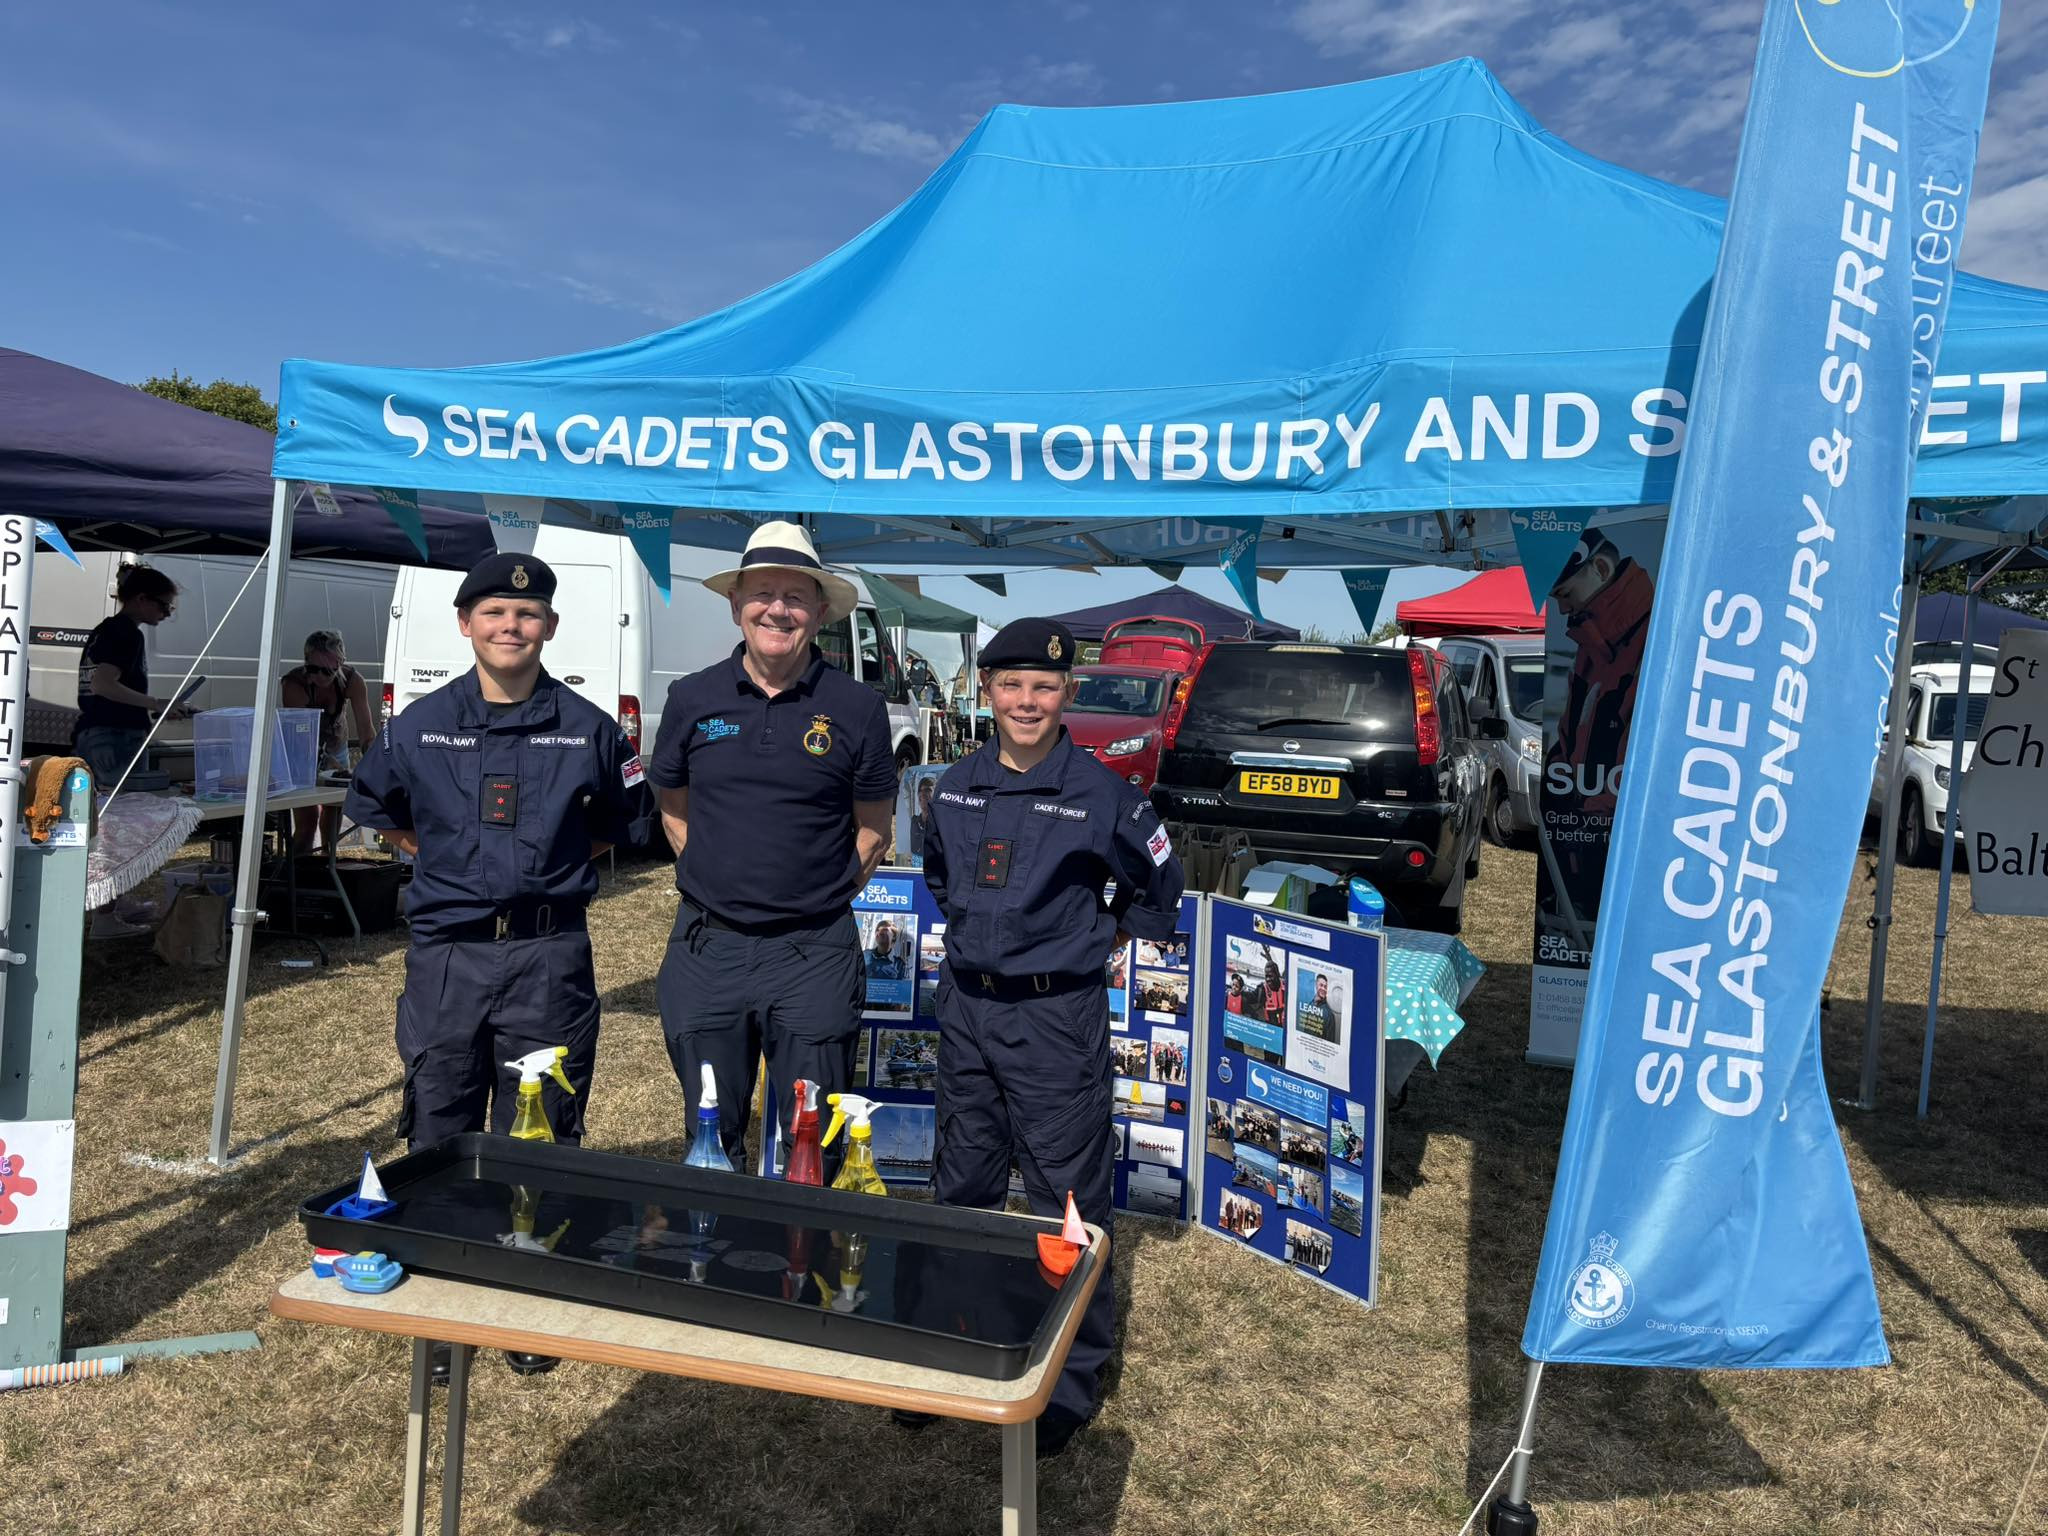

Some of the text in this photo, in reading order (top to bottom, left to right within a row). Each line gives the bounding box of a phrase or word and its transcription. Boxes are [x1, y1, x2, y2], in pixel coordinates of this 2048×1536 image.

[442, 370, 2047, 482] SEA CADETS GLASTONBURY AND SET
[502, 511, 519, 519] SEA
[635, 511, 653, 519] SEA
[1532, 510, 1557, 520] SEA
[502, 519, 537, 529] CADETS
[636, 518, 670, 529] CADETS
[1531, 521, 1582, 532] CADETS
[0, 519, 23, 676] SPLAT
[1696, 102, 1899, 1118] GLASTONBURY & STREET
[411, 669, 449, 677] TRANSIT
[1994, 656, 2040, 698] St
[708, 725, 740, 733] CADETS
[421, 734, 477, 747] ROYAL NAVY
[530, 736, 586, 746] CADET FORCES
[1247, 774, 1332, 795] EF58 BYD
[939, 792, 986, 808] ROYAL NAVY
[1182, 797, 1221, 807] X-TRAIL
[1034, 803, 1087, 819] CADET FORCES
[1545, 810, 1613, 828] Grab your
[1545, 830, 1553, 840] a
[1556, 828, 1599, 843] better
[1636, 590, 1763, 1106] SEA CADETS
[867, 885, 888, 895] SEA
[866, 894, 909, 905] CADETS
[1540, 935, 1569, 949] SEA
[1299, 1001, 1324, 1017] LEARN
[1270, 1075, 1323, 1102] WE NEED YOU!
[1605, 1259, 1631, 1287] CORPS
[1585, 1319, 1603, 1328] AYE
[1604, 1304, 1629, 1326] READY
[1645, 1319, 1678, 1333] Charity
